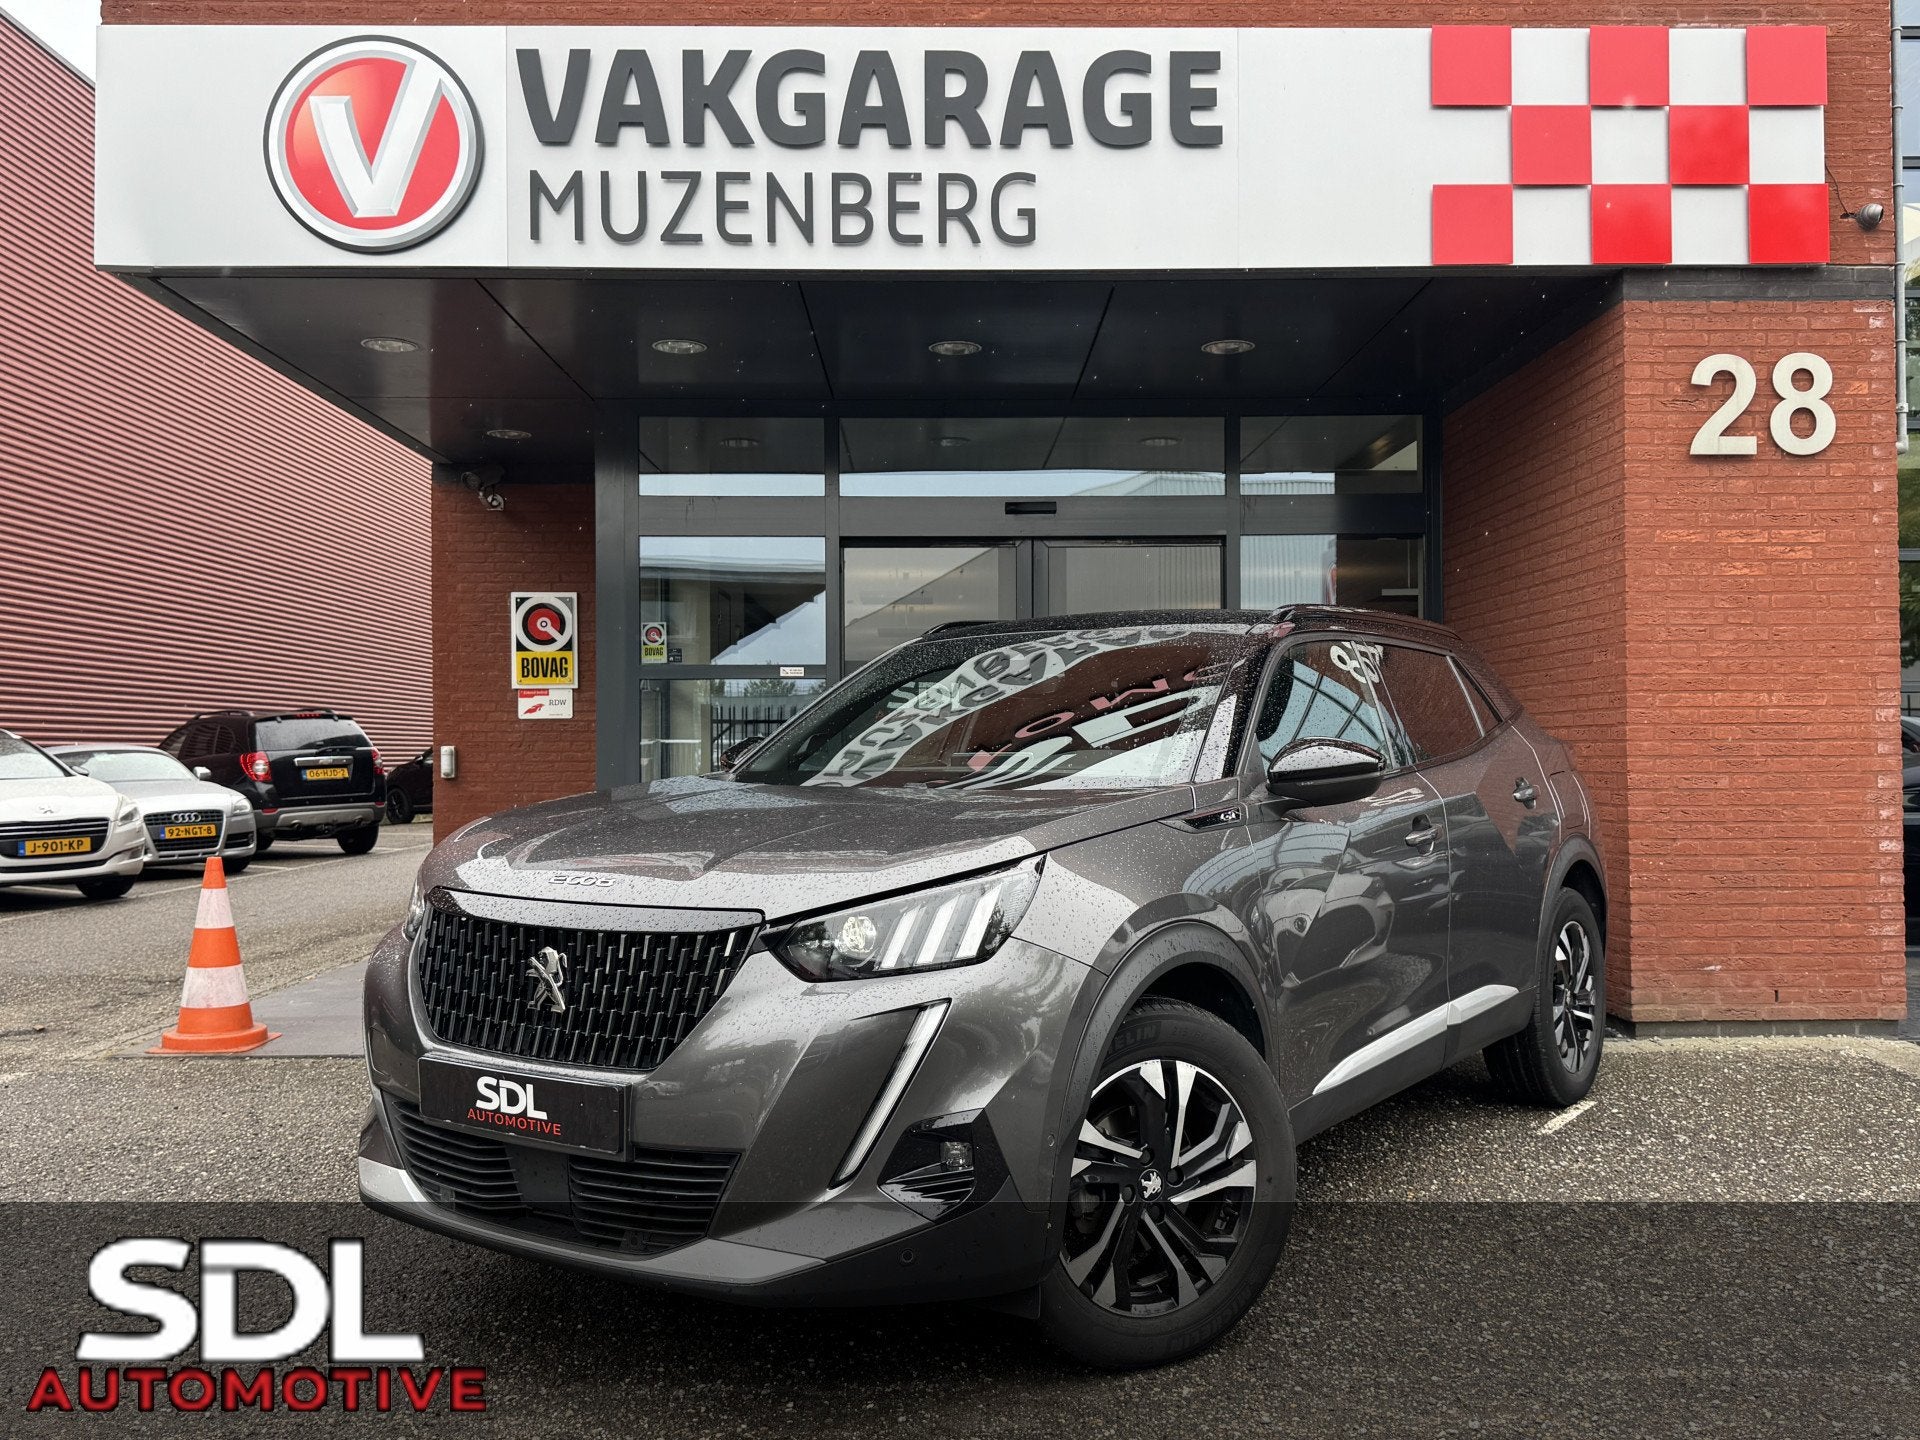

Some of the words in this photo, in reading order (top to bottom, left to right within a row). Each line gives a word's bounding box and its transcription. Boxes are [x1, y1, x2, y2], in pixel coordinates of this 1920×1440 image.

[515, 48, 1224, 147] VAKGARAGE
[528, 168, 1037, 246] MUZENBERG
[1690, 352, 1836, 455] 28
[644, 646, 664, 656] BOVAG
[521, 657, 568, 678] BOVAG
[30, 839, 84, 853] J-901-KP
[168, 826, 213, 837] 92-NGT-8
[475, 1076, 548, 1120] SDL
[467, 1107, 562, 1136] AUTOMOTIVE
